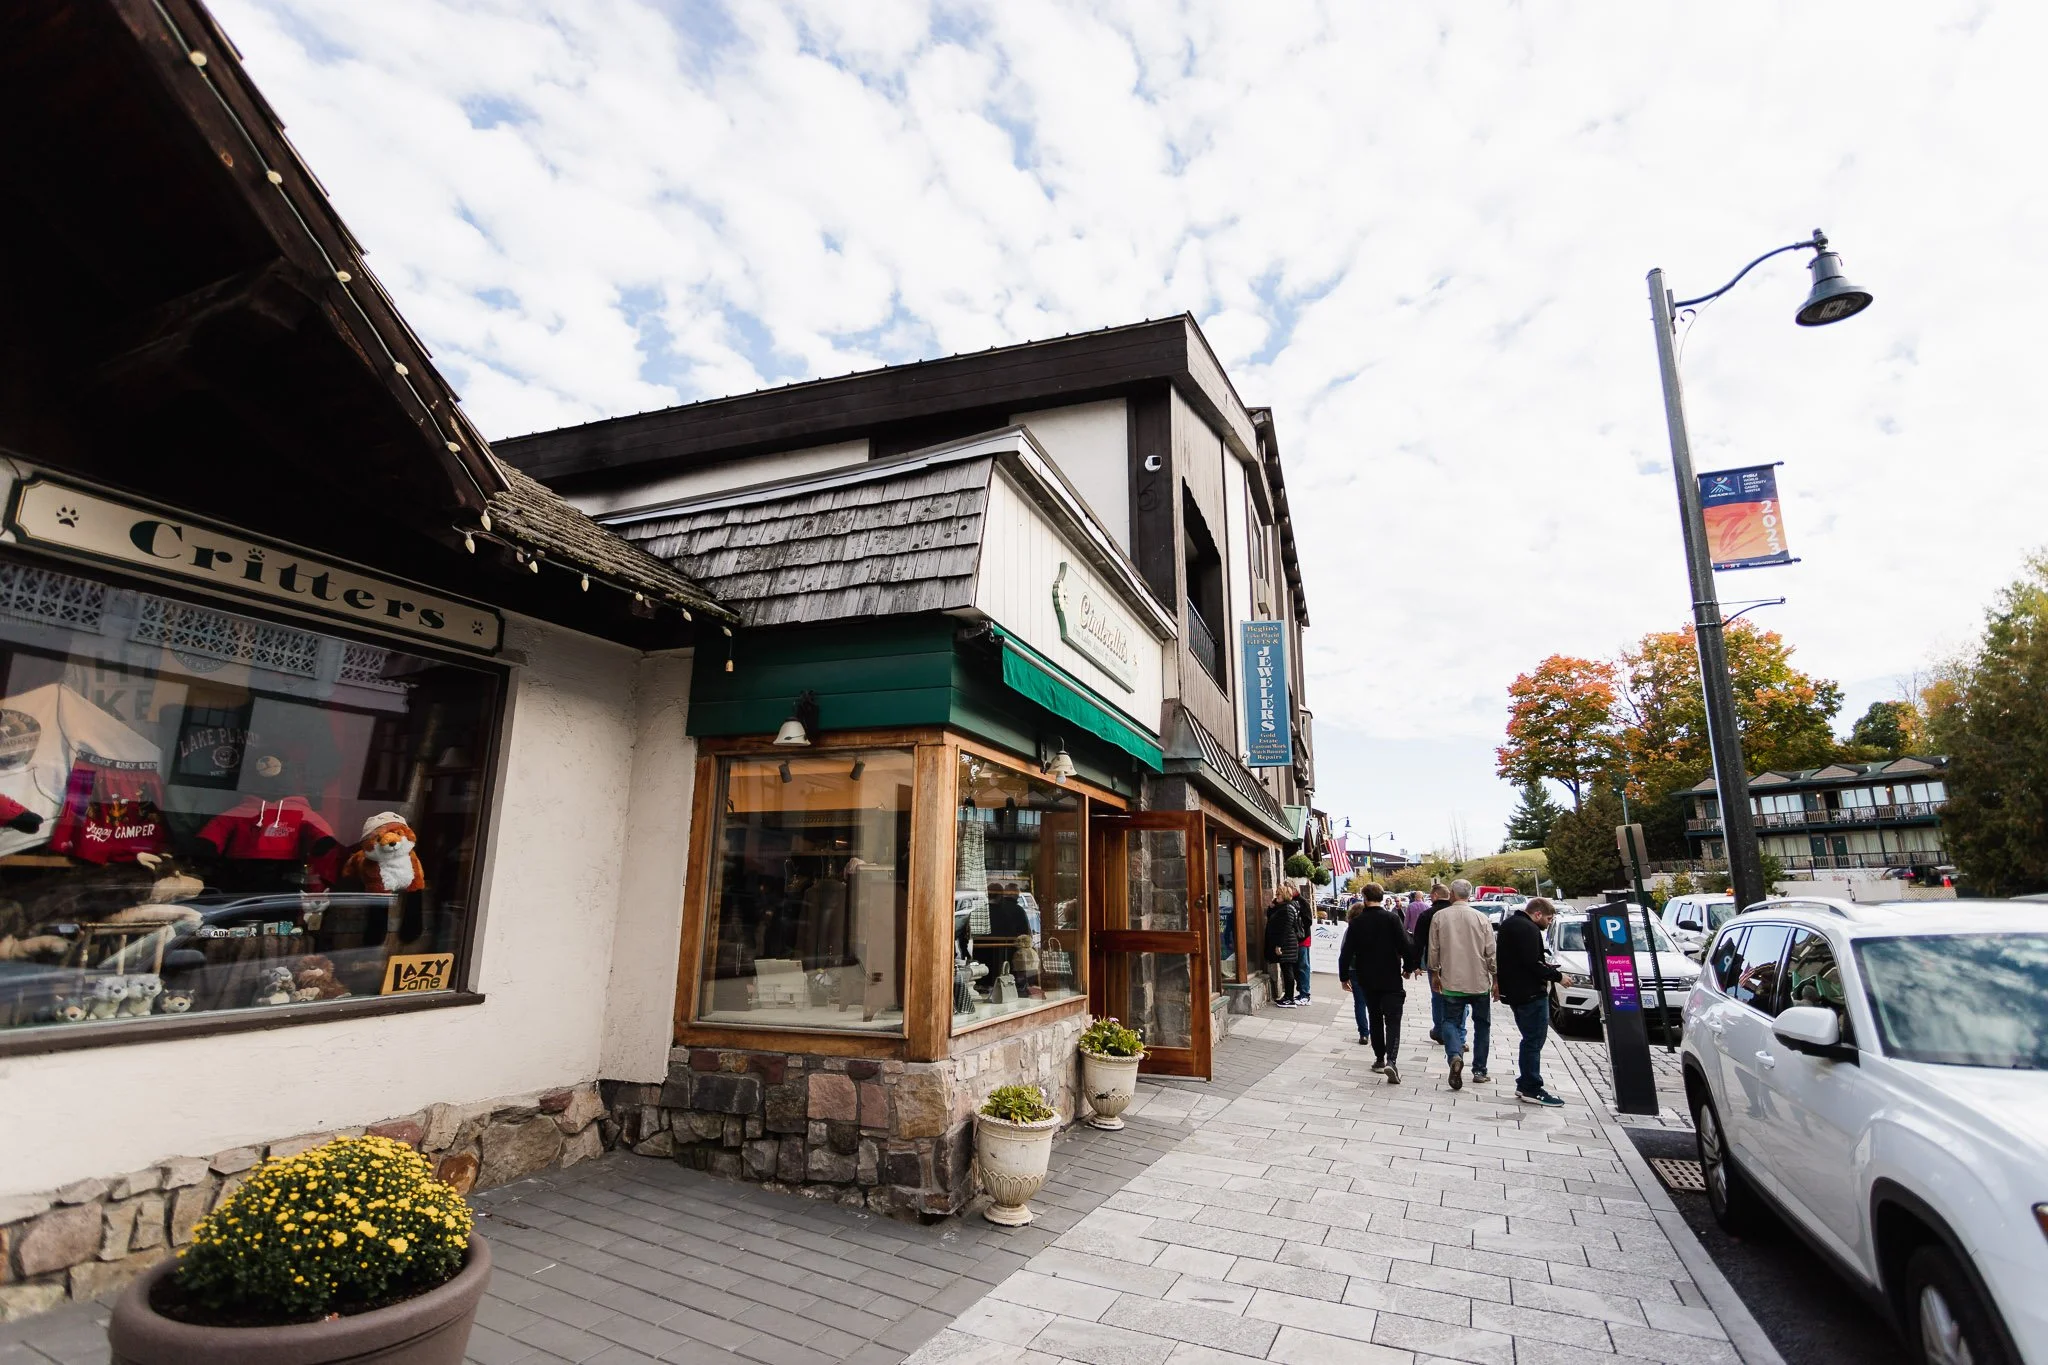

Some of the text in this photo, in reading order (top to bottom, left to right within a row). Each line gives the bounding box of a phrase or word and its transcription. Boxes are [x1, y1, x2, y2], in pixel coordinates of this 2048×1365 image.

[1761, 500, 1780, 555] 2023
[130, 520, 444, 629] Critters
[1257, 646, 1275, 731] JEWELERS
[180, 728, 215, 758] LAKE
[114, 823, 155, 839] CAMPER
[1605, 919, 1621, 939] P
[392, 958, 449, 991] LAZY
